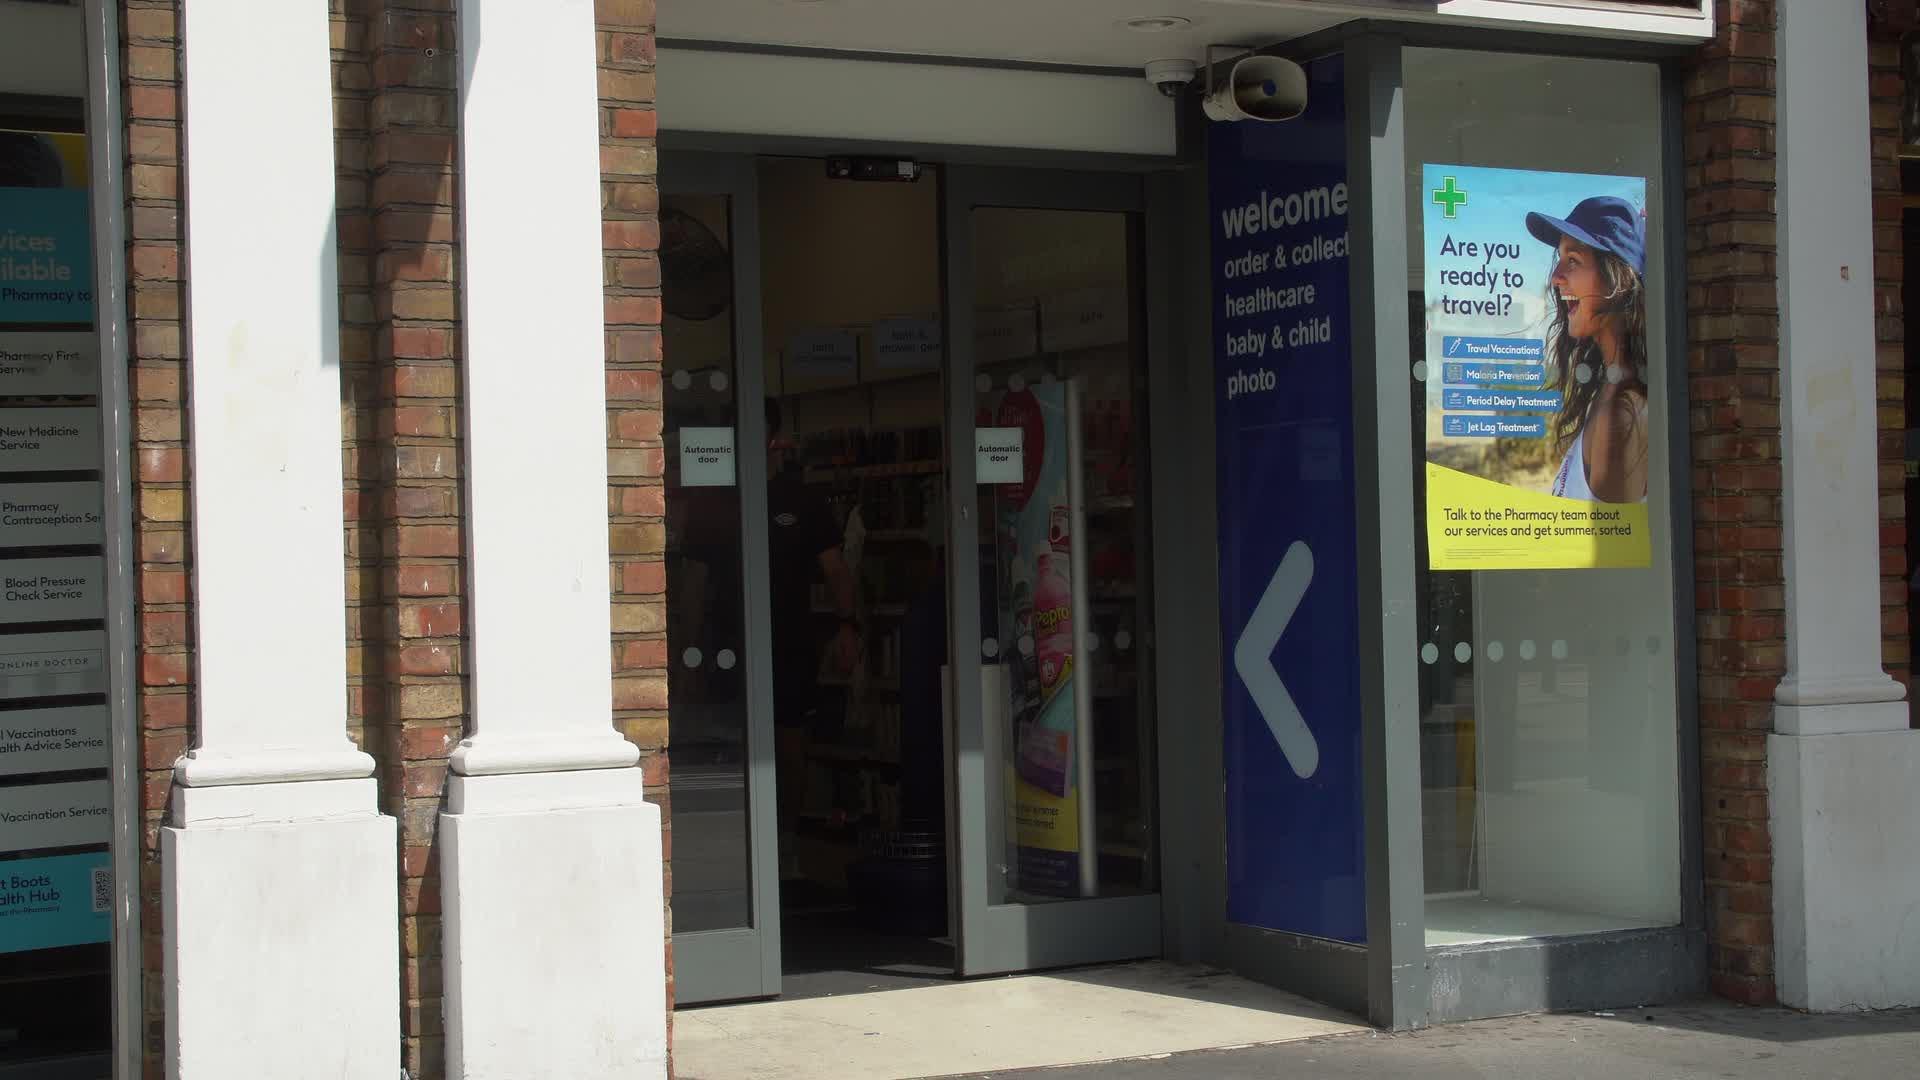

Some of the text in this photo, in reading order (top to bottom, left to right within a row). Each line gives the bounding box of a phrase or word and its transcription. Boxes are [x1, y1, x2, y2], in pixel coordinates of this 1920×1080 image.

[1222, 181, 1348, 239] welcome
[1224, 231, 1350, 279] order & collect
[1440, 233, 1520, 264] Are you
[1440, 264, 1524, 293] ready to
[2, 288, 74, 304] Pharmacy
[1225, 283, 1316, 318] healthcare
[1441, 294, 1513, 316] travel?
[1226, 316, 1331, 357] baby & child
[1466, 343, 1490, 353] Travel
[1466, 370, 1497, 379] Malaria
[1228, 367, 1276, 400] photo
[1466, 395, 1492, 406] Period
[1493, 396, 1516, 408] Delay
[0, 426, 79, 437] New Medicine
[1467, 422, 1479, 433] Jet
[1480, 423, 1496, 433] Lag
[0, 440, 40, 450] Service
[685, 446, 732, 454] Automatic
[978, 445, 1020, 453] Automatic
[3, 502, 59, 514] Pharmacy
[3, 514, 82, 526] Contraception
[1443, 508, 1620, 524] Talk to the Pharmacy team about
[1444, 527, 1463, 536] our
[1466, 524, 1508, 536] services
[1510, 524, 1532, 536] and
[1534, 525, 1552, 539] get
[1599, 524, 1632, 536] sorted
[5, 576, 86, 588] Blood Pressure
[6, 589, 83, 601] Check Service
[45, 657, 89, 667] DOCTOR
[7, 728, 77, 739] Vaccinations
[24, 741, 62, 752] Advice
[64, 737, 104, 749] Service
[1, 804, 108, 823] Vaccination Service
[11, 875, 51, 889] Boots
[30, 888, 60, 903] Hub
